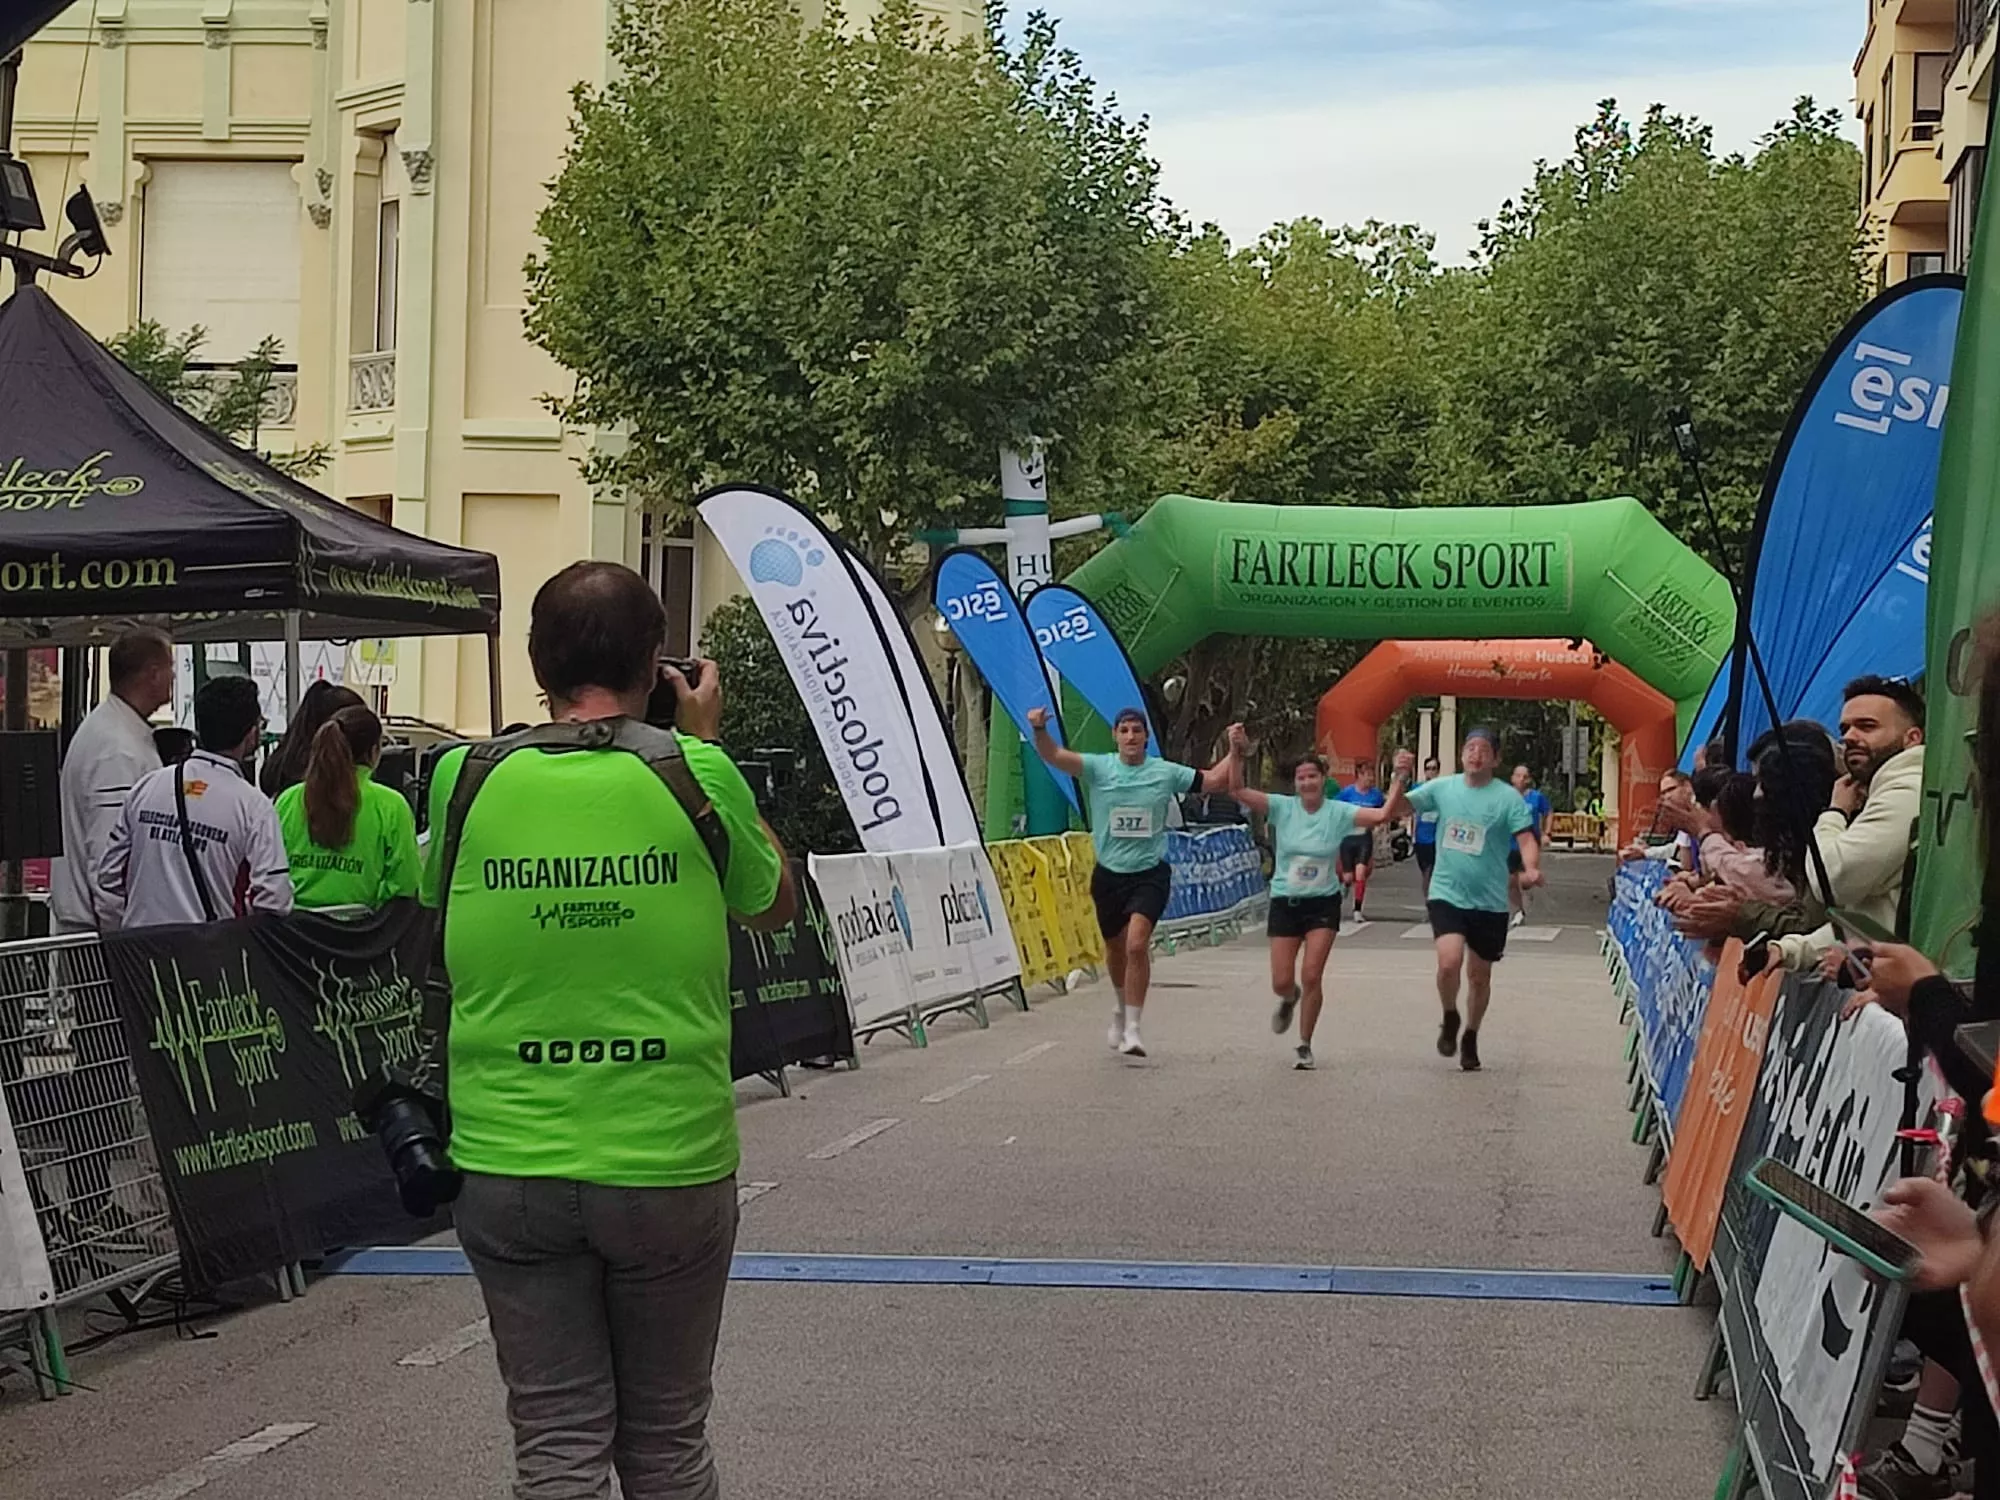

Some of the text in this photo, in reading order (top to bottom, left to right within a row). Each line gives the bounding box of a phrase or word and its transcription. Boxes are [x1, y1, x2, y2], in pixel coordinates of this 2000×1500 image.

[1230, 538, 1557, 590] FARTLECK SPORT
[1535, 650, 1589, 665] Huesca
[483, 845, 679, 891] ORGANIZACIÓN
